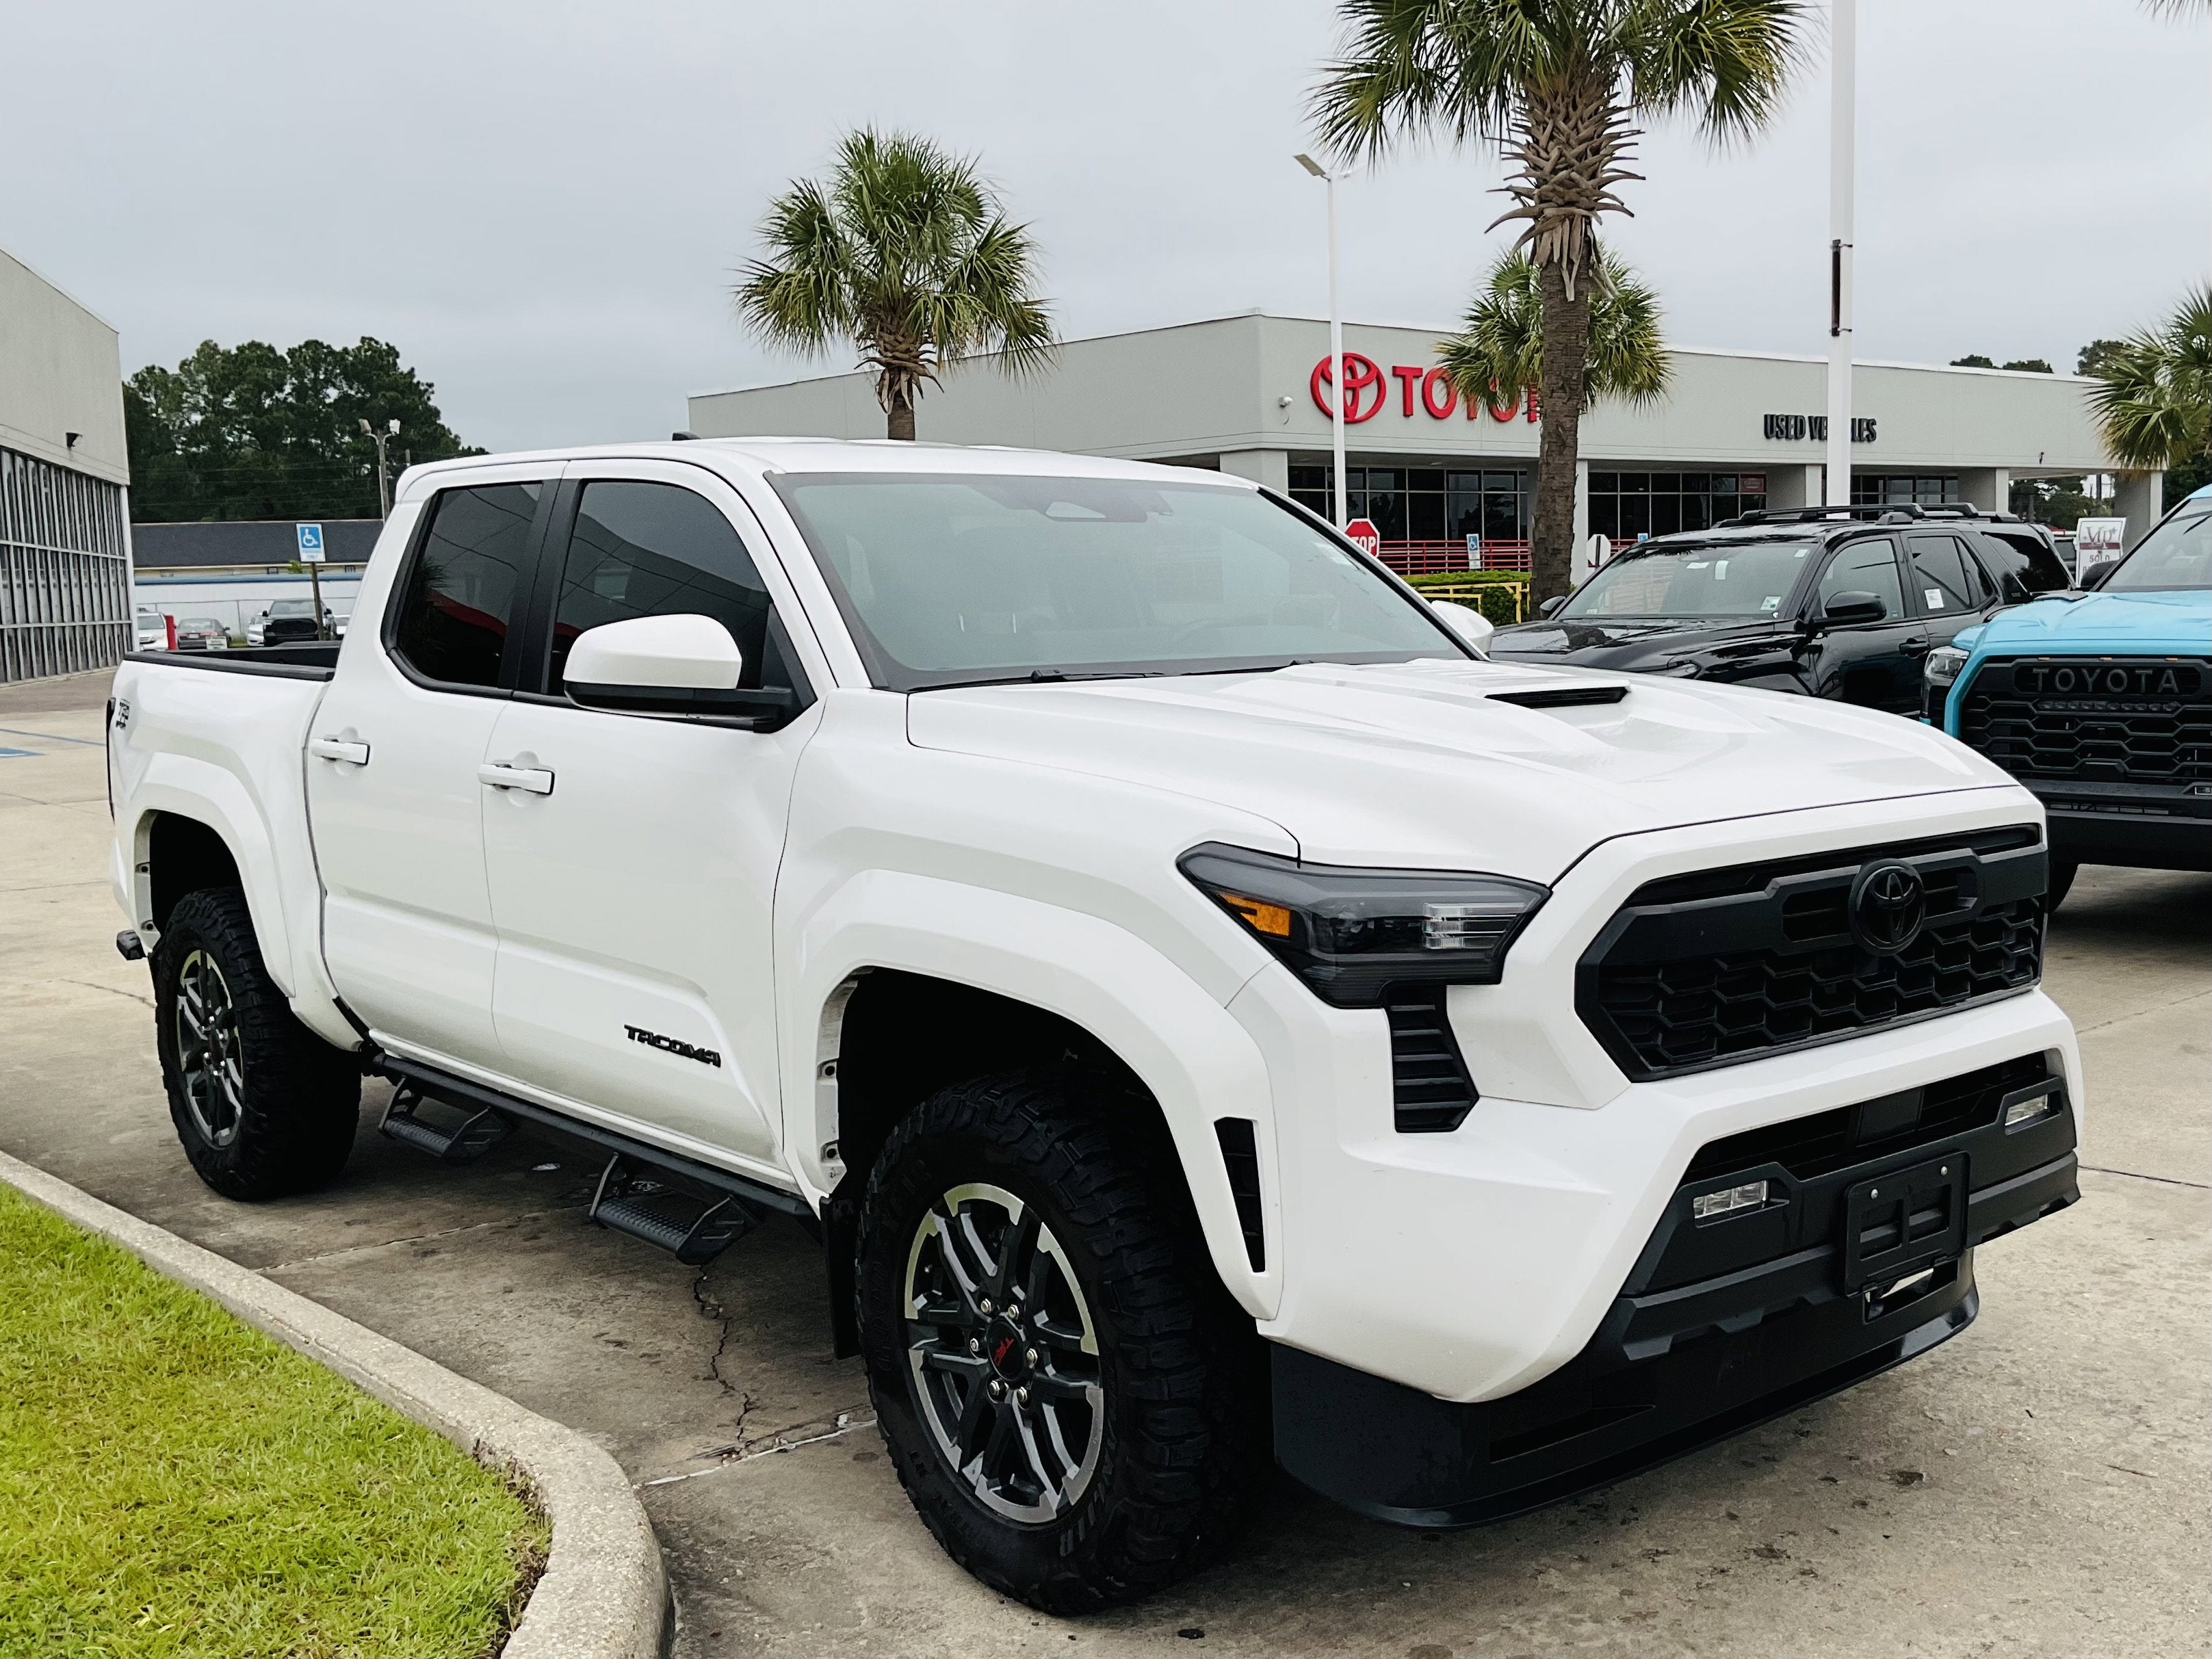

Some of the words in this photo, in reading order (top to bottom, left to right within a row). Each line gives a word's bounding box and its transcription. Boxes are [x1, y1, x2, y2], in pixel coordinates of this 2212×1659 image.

[1764, 414, 1806, 439] USED
[1808, 415, 1877, 442] VELES
[2033, 668, 2179, 693] TOYOTA
[624, 1024, 721, 1067] TACOMA
